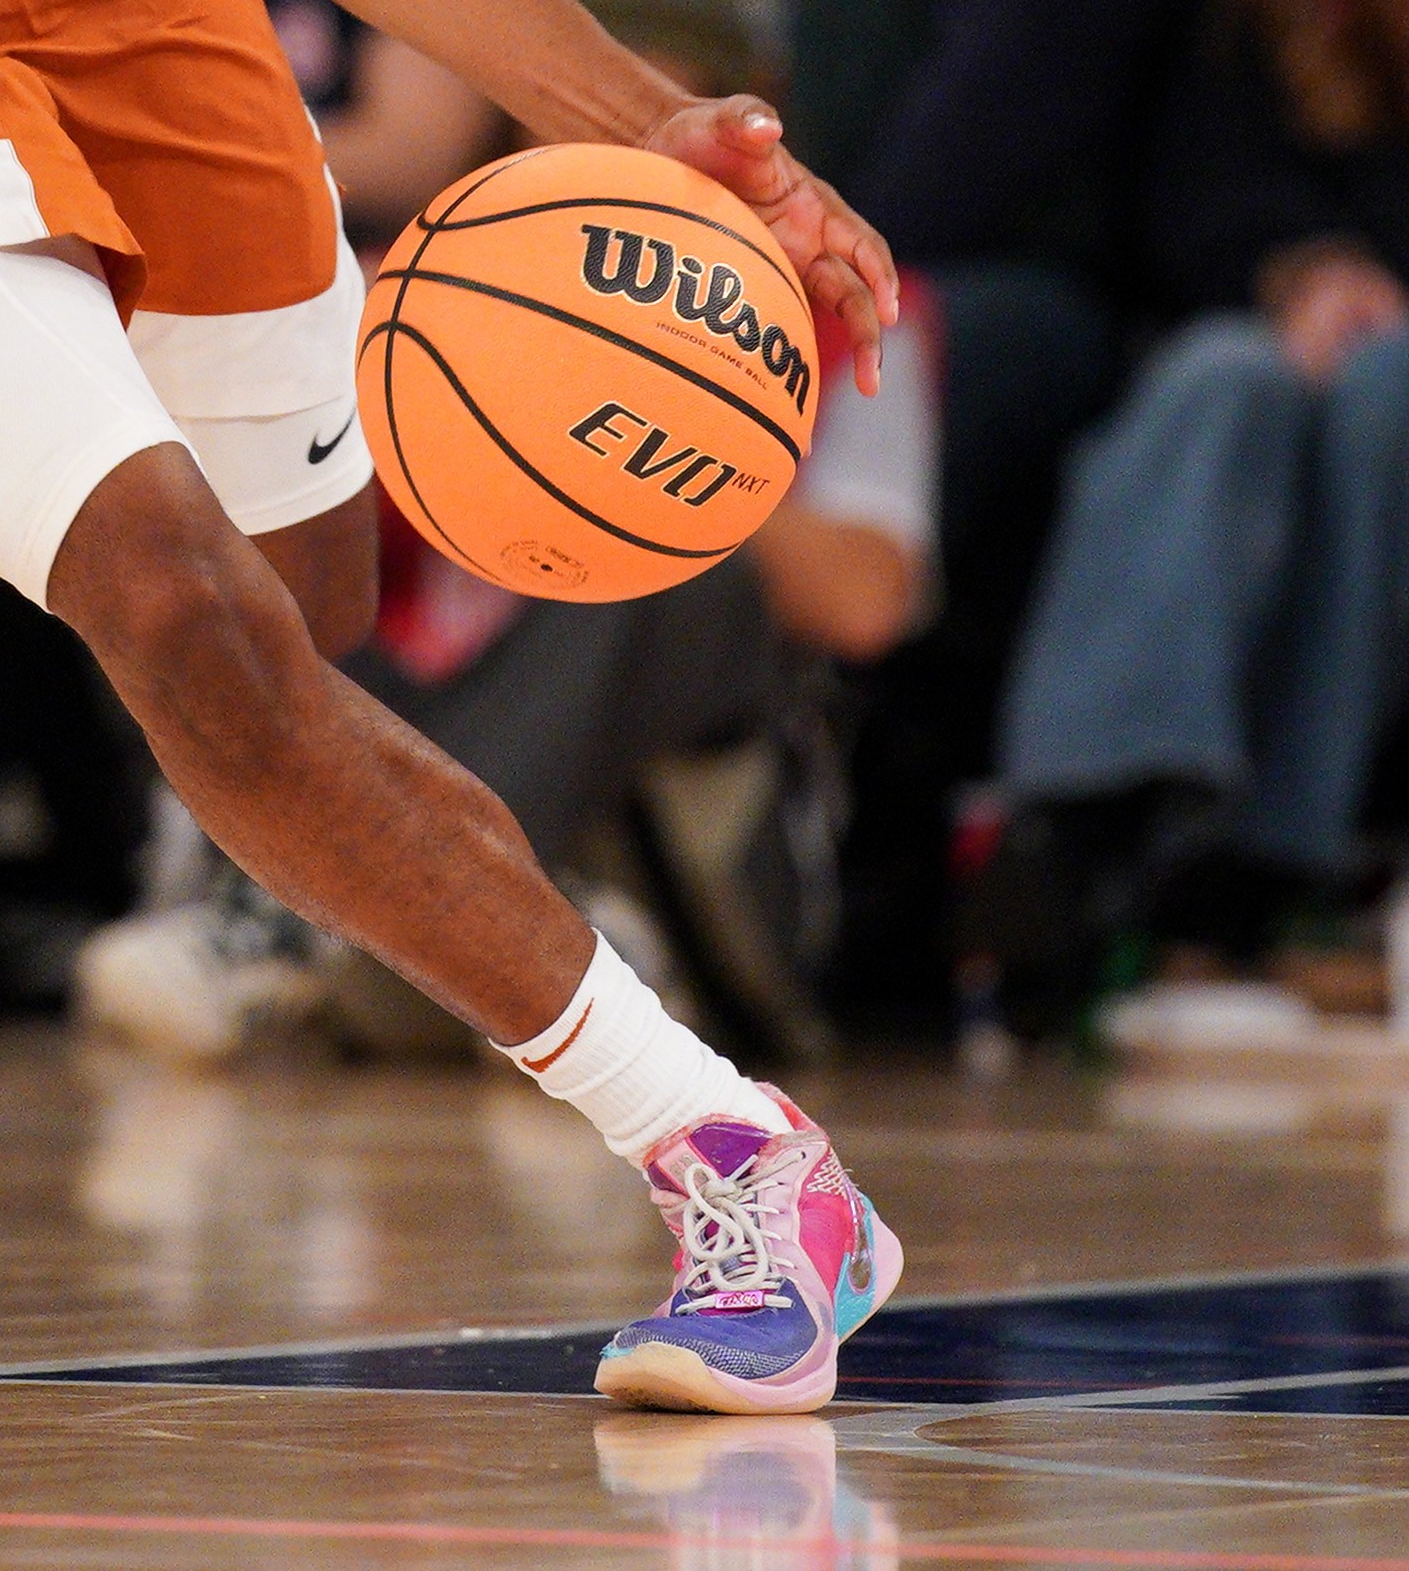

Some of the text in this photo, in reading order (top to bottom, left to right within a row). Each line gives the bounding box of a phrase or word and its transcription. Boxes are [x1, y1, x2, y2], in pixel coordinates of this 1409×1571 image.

[580, 223, 811, 417] Wilson
[656, 321, 769, 391] INDOOR GAME BALL
[732, 472, 771, 495] NXT
